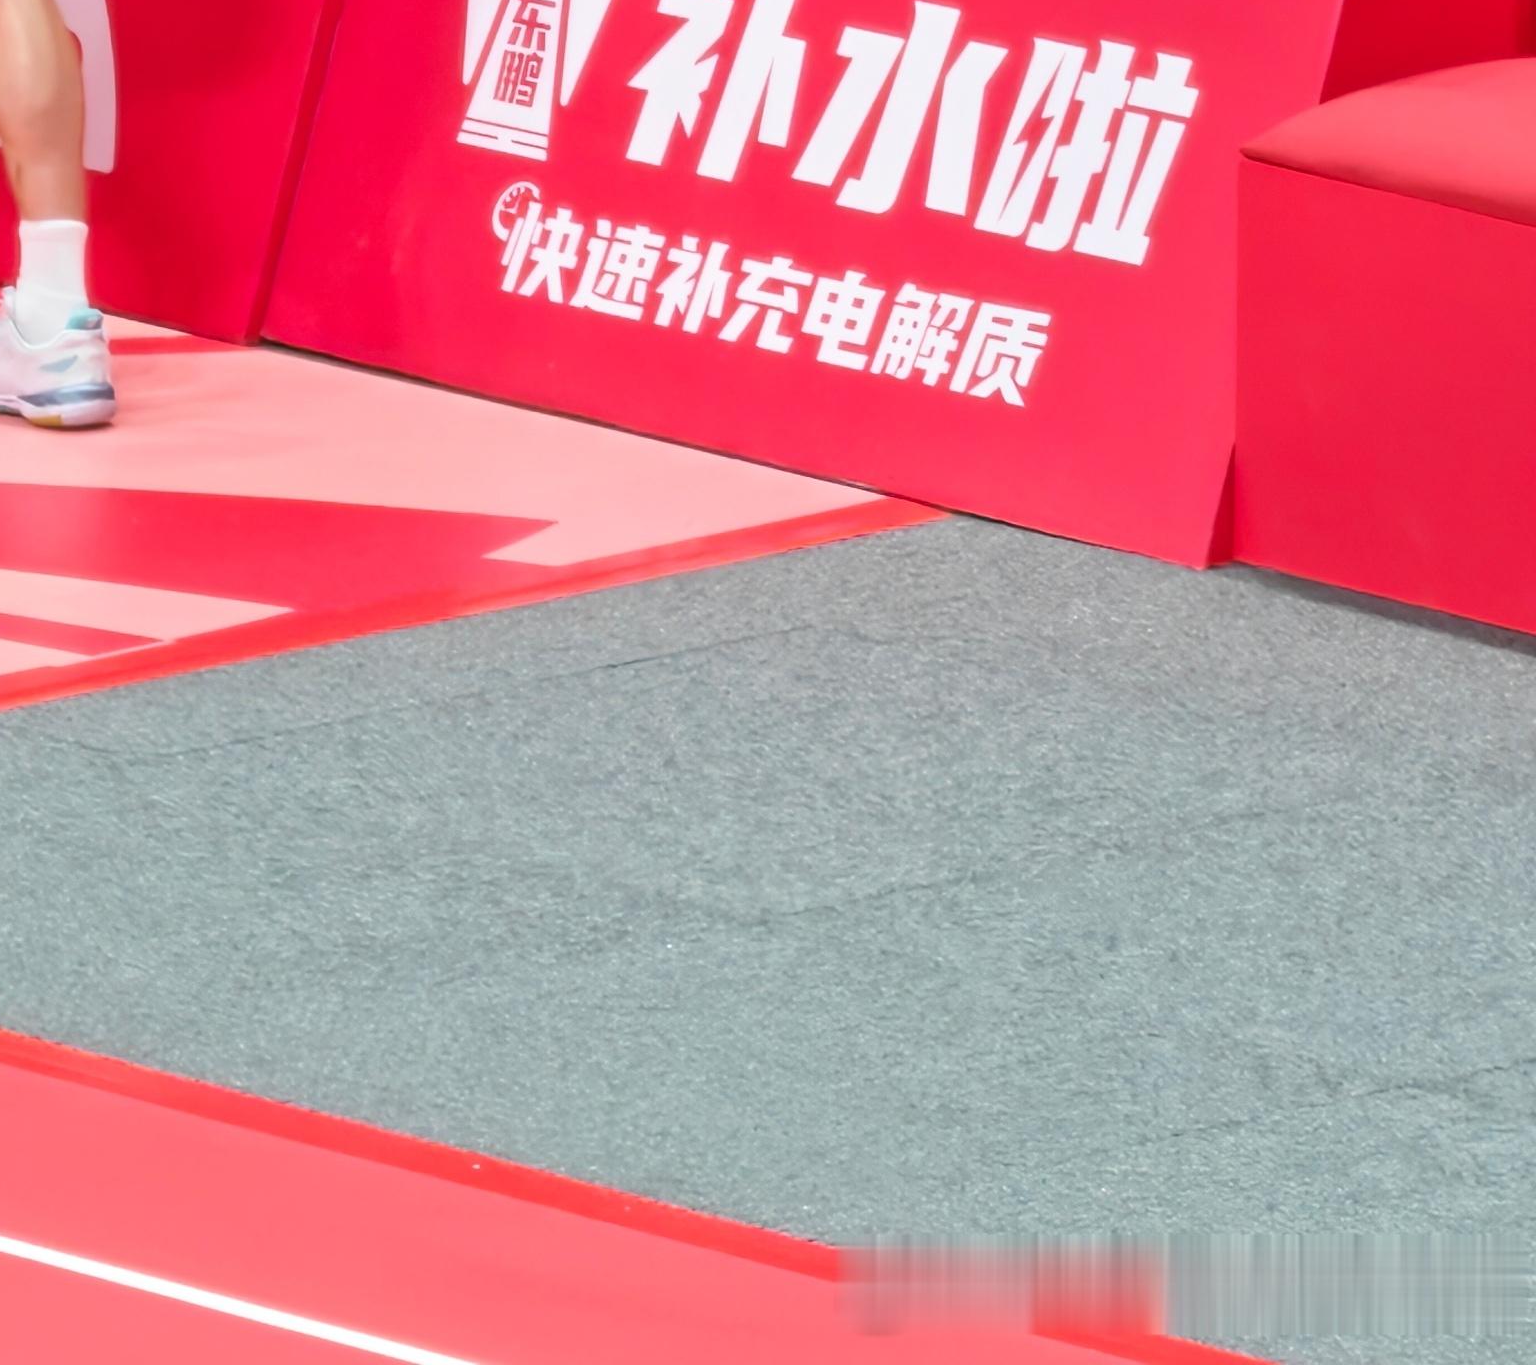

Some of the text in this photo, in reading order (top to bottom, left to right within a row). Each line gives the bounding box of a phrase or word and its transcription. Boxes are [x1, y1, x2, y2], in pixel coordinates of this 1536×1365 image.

[500, 199, 1053, 409] 快速补充电解质
